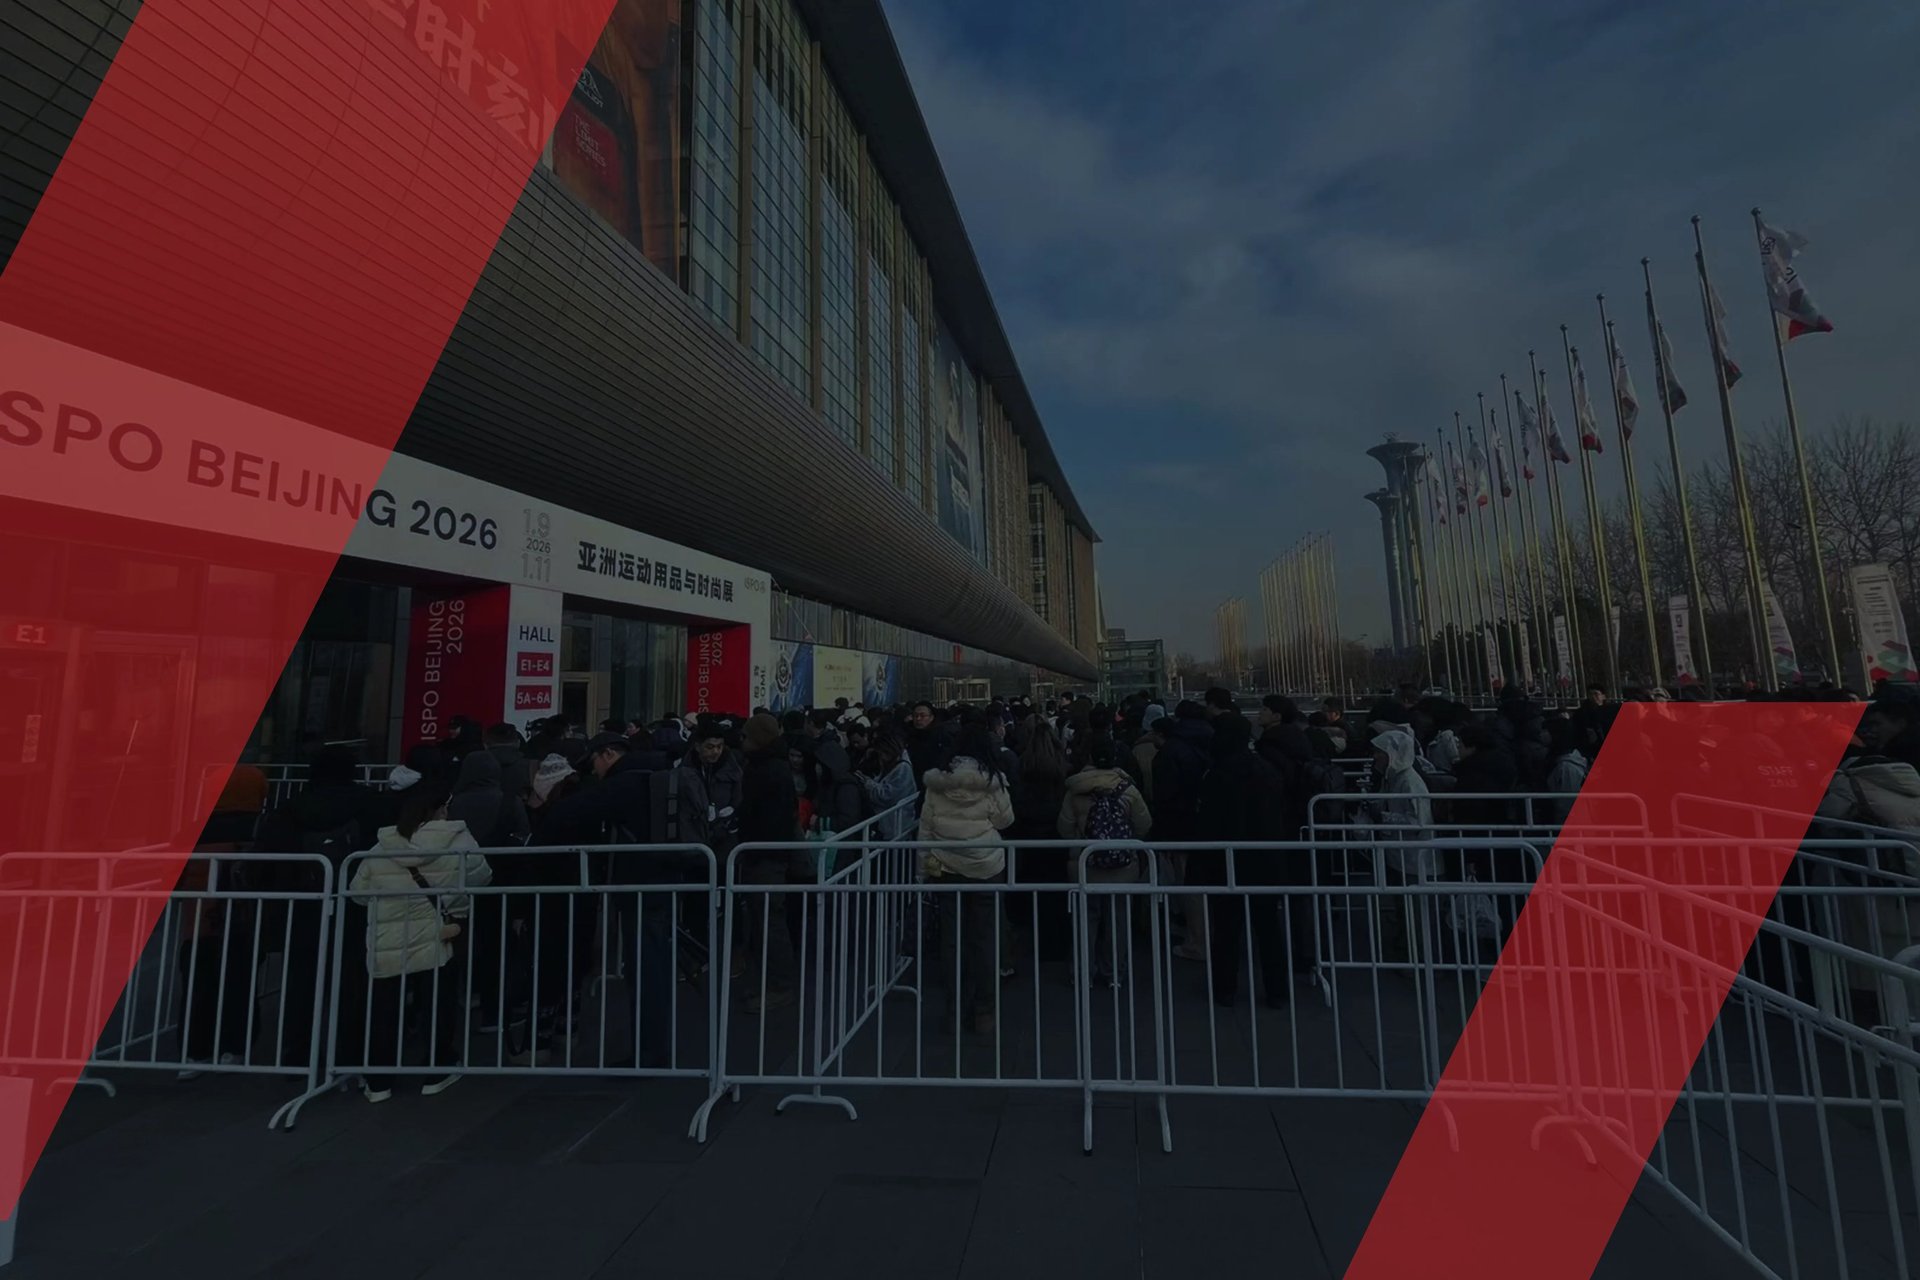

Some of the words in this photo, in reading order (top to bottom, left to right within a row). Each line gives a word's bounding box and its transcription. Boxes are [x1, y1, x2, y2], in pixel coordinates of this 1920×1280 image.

[0, 390, 163, 472] SPO
[187, 439, 397, 528] BEIJING
[410, 500, 498, 550] 2026
[522, 508, 550, 538] 1.9
[526, 537, 551, 554] 2026
[521, 552, 551, 583] 1.11
[577, 540, 734, 602] 亚洲运动用品与时尚展
[16, 624, 46, 644] E1
[424, 599, 445, 682] BEIJING
[446, 599, 465, 654] 2026
[519, 625, 554, 643] HALL
[698, 633, 710, 684] BEIJING
[711, 632, 723, 666] 2026
[520, 658, 550, 672] E1-E4
[516, 691, 551, 705] 5A-6A
[698, 687, 709, 713] SPO
[420, 690, 440, 740] ISPO
